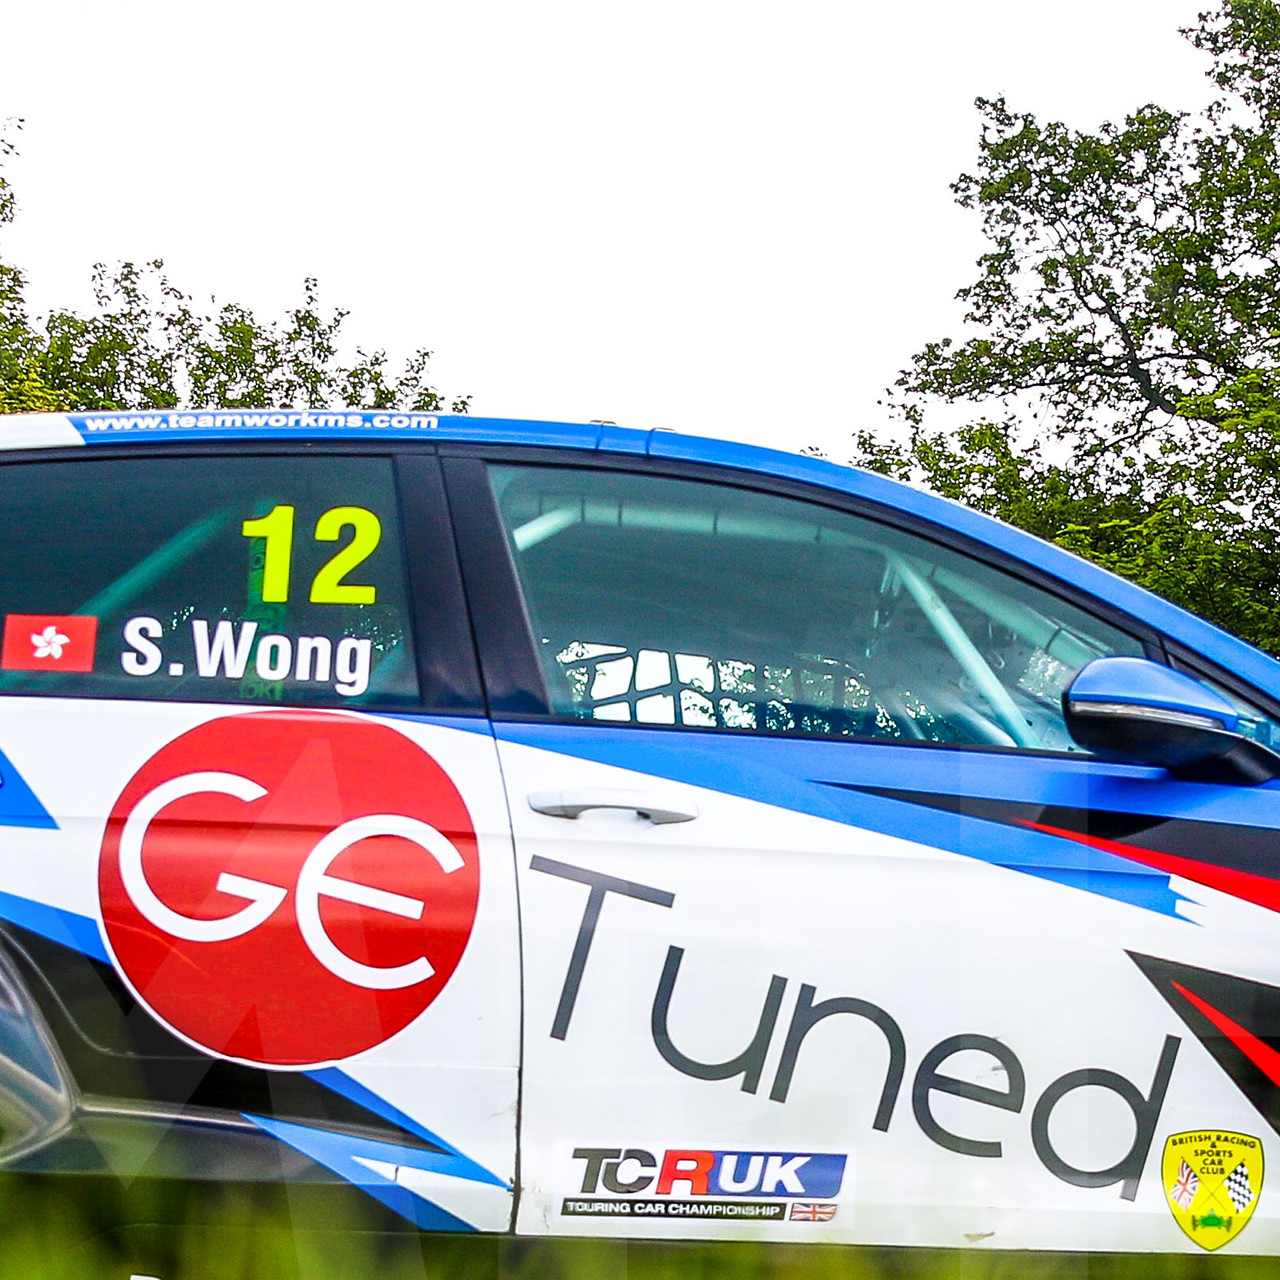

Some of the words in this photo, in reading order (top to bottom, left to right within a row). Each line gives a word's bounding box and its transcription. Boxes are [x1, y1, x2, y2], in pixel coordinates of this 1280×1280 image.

[84, 412, 439, 432] www.teamworkms.com
[241, 504, 383, 606] 12
[120, 615, 373, 697] S.Wong
[118, 770, 466, 990] GE
[528, 854, 1182, 1202] Tuned
[1171, 1134, 1211, 1146] BRITISH
[1216, 1134, 1257, 1148] RACING
[1193, 1149, 1233, 1158] SPORTS
[1202, 1158, 1223, 1166] CAR
[572, 1147, 715, 1196] TCR
[717, 1154, 813, 1195] UK
[1200, 1167, 1226, 1175] CLUB
[565, 1200, 631, 1214] TOURING
[634, 1202, 665, 1215] CAR
[667, 1203, 781, 1217] CHAMPIONSHIP
